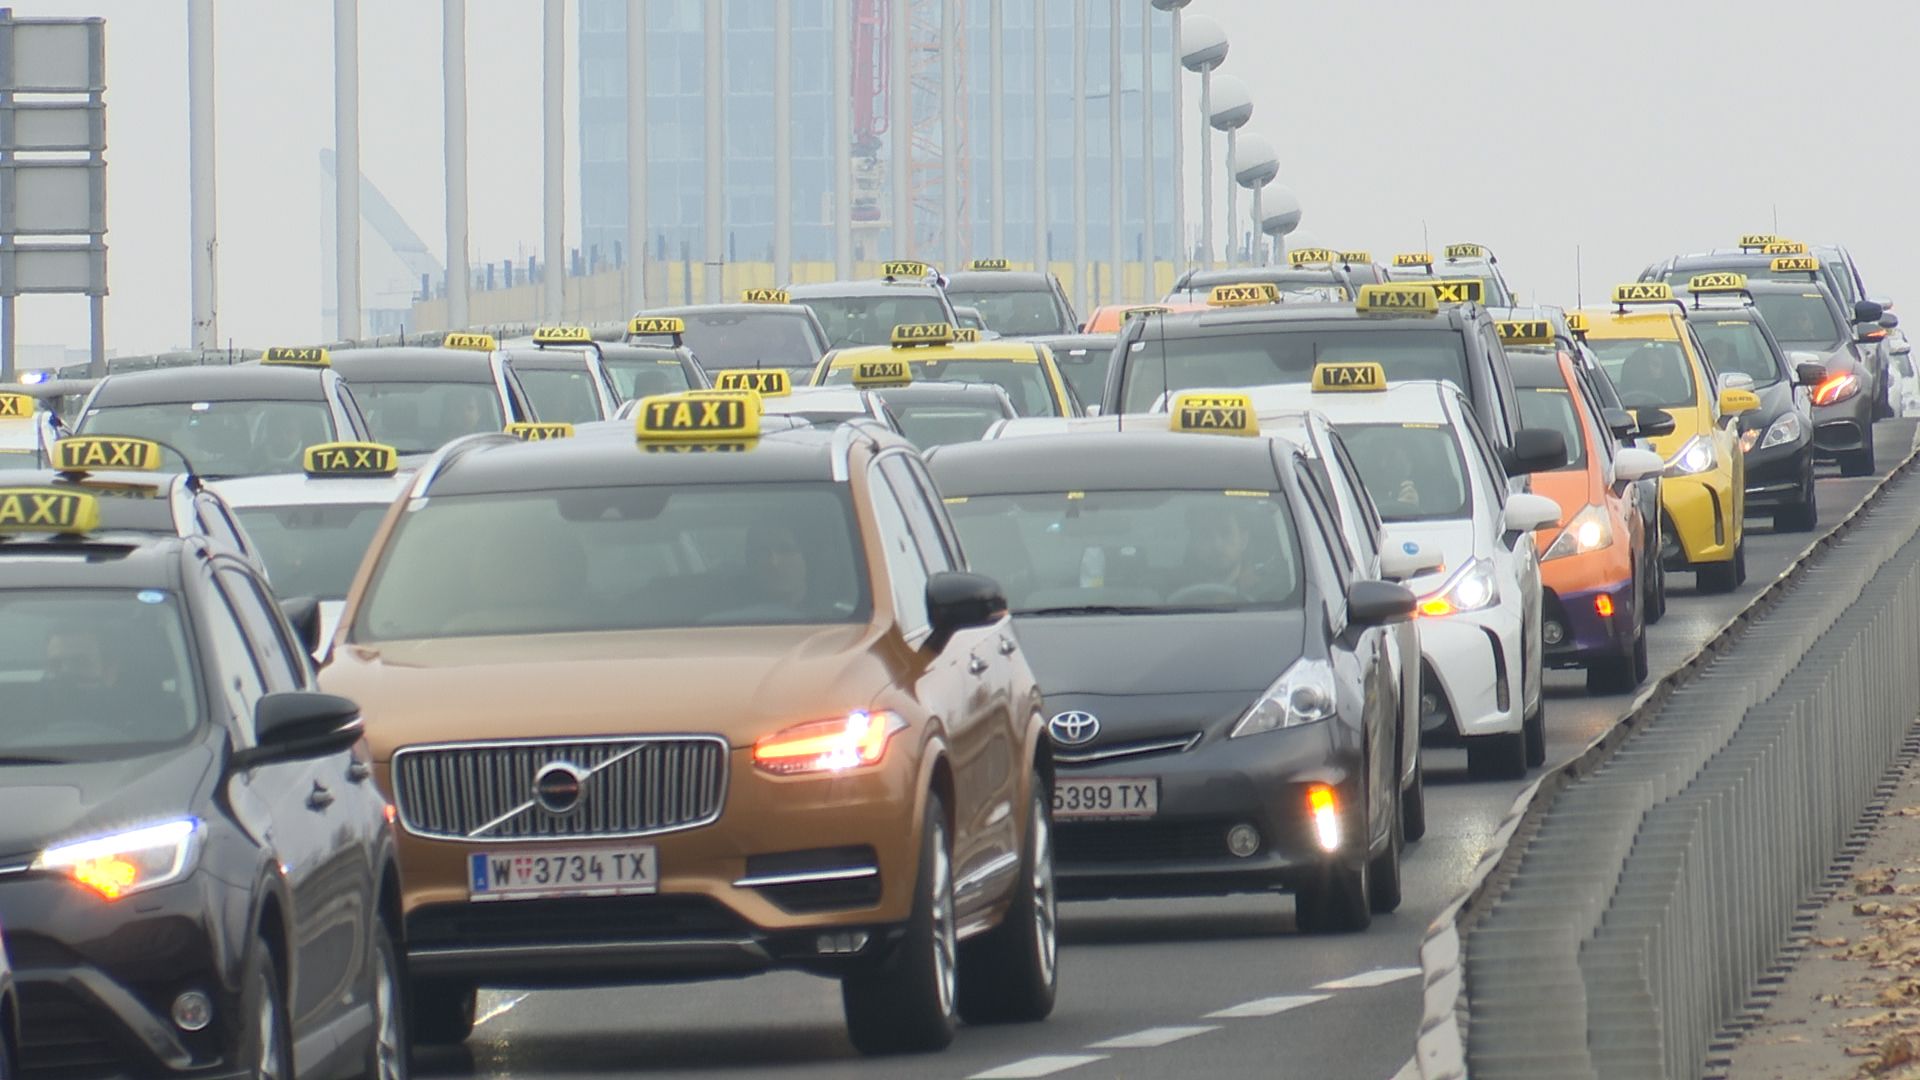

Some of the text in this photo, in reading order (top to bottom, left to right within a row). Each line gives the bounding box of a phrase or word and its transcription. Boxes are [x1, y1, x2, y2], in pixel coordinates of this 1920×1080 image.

[1744, 235, 1775, 244] TAXI
[1451, 245, 1478, 257] TAXI
[1771, 245, 1801, 254] TAXI
[1295, 250, 1328, 262] TAXI
[1401, 255, 1428, 264] TAXI
[888, 264, 921, 275] TAXI
[978, 260, 1004, 268] TAXI
[1779, 259, 1811, 269] TAXI
[1696, 275, 1736, 287] TAXI
[751, 289, 785, 301] TAXI
[1218, 288, 1259, 301] TAXI
[1372, 291, 1424, 306] TAXI
[1620, 286, 1666, 299] TAXI
[637, 320, 675, 331] TAXI
[902, 325, 944, 337] TAXI
[1496, 323, 1537, 338] AXI
[543, 327, 584, 338] TAXI
[452, 336, 487, 348] TAXI
[274, 349, 318, 360] TAXI
[862, 364, 901, 377] TAXI
[1325, 367, 1374, 384] TAXI
[725, 374, 778, 392] TAXI
[652, 401, 738, 428] TAXI
[1185, 409, 1243, 428] TAXI
[514, 427, 563, 442] TAXI
[65, 441, 142, 466] TAXI
[316, 450, 383, 470] TAXI
[0, 494, 72, 525] AXI
[1118, 784, 1148, 809] TX
[491, 853, 646, 887] W 3734 TX
